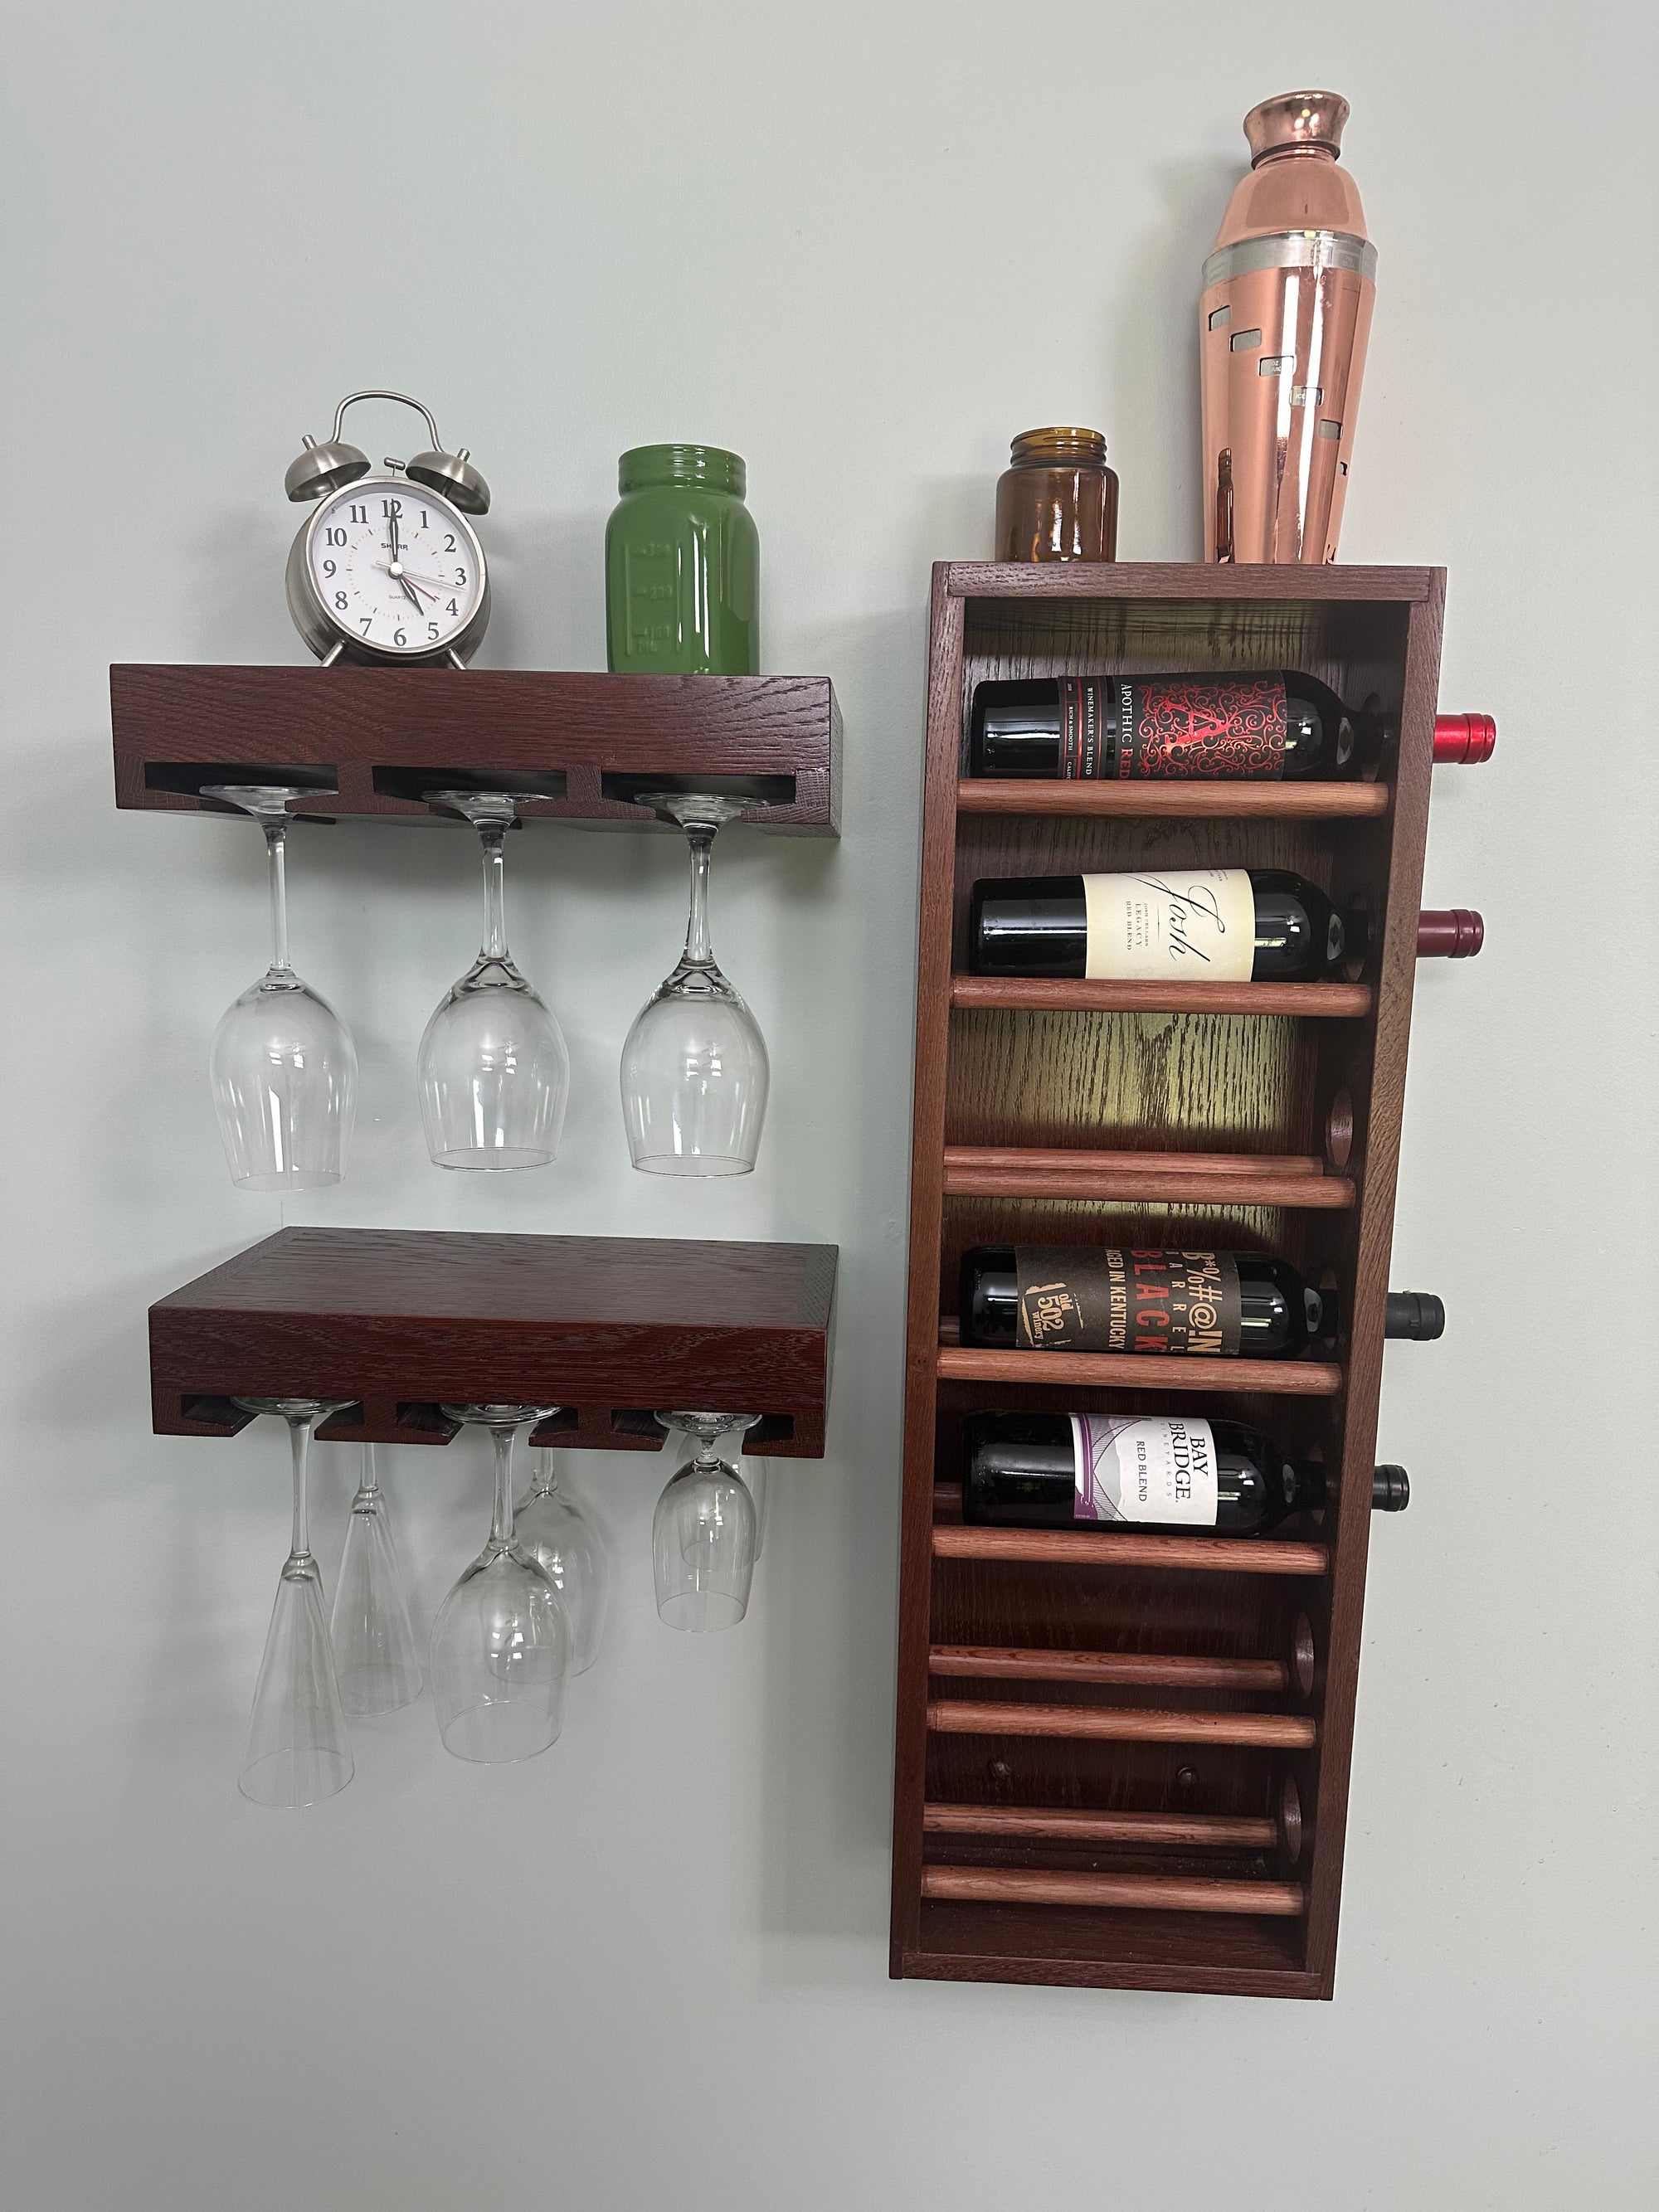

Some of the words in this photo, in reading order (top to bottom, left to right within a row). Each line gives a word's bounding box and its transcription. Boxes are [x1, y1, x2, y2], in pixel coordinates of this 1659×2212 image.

[349, 504, 369, 523] 11
[382, 499, 403, 518] 12
[421, 510, 430, 529] 1
[325, 527, 348, 547] 10
[443, 534, 457, 552] 2
[323, 560, 337, 578] 9
[455, 567, 467, 586] 3
[335, 591, 348, 610] 8
[445, 598, 459, 616] 4
[359, 618, 372, 636] 7
[393, 628, 406, 646] 6
[427, 622, 440, 640] 5
[1086, 687, 1095, 743] WINEMAKER'S
[1121, 683, 1133, 743] APOTHIC
[1085, 746, 1094, 775] BLEND
[1120, 748, 1133, 779] RED
[1120, 873, 1225, 962] Josh
[1105, 1249, 1124, 1268] AGED
[1108, 1271, 1126, 1282] IN
[1058, 1293, 1074, 1311] old
[1131, 1250, 1170, 1351] BLACK
[1165, 1251, 1187, 1351] BARREL
[1038, 1295, 1064, 1331] 502
[1109, 1286, 1127, 1349] KENTUCKY
[1031, 1310, 1044, 1339] winery
[1136, 1441, 1146, 1461] RED
[1160, 1422, 1173, 1498] VINEYARDS
[1190, 1437, 1209, 1477] BAY
[1138, 1465, 1147, 1502] BLEND
